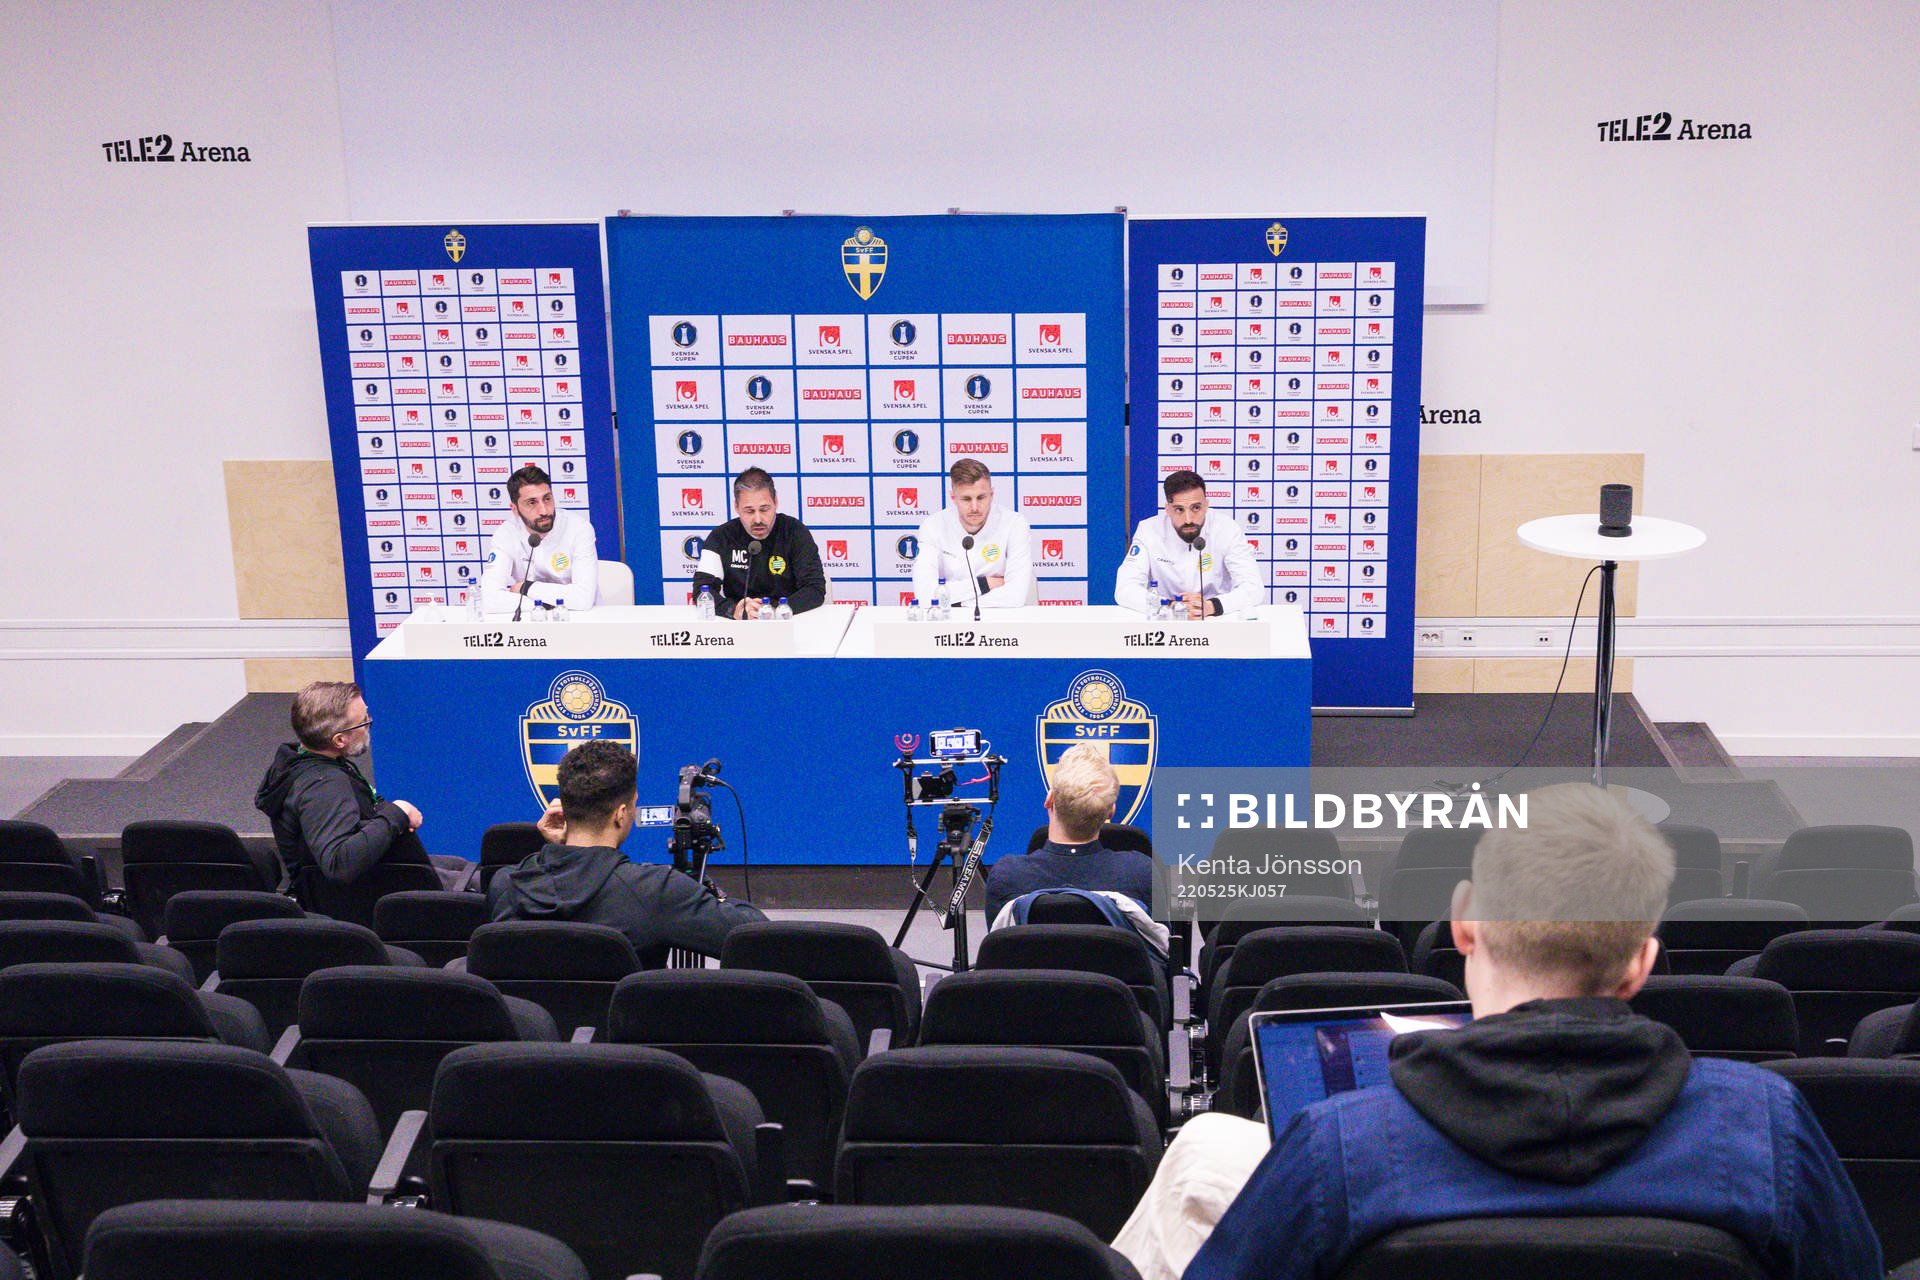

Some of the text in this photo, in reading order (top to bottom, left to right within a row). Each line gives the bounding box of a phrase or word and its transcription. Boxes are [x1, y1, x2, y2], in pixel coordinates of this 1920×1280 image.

[1598, 112, 1752, 142] TELE2 Arena
[102, 134, 251, 162] TELE2 Arena
[728, 335, 787, 345] BAUHAUS
[946, 334, 1006, 344] BAUHAUS
[802, 389, 862, 399] BAUHAUS
[1022, 388, 1081, 398] BAUHAUS
[1420, 405, 1482, 424] Arena
[732, 444, 791, 454] BAUHAUS
[949, 443, 1008, 453] BAUHAUS
[806, 496, 864, 507] BAUHAUS
[1023, 496, 1082, 506] BAUHAUS
[732, 549, 748, 563] MC
[464, 632, 547, 647] TELE2 Arena
[651, 631, 734, 646] TELE2 Arena
[934, 632, 1018, 646] TELE2 Arena
[1124, 631, 1209, 646] TELE2 Arena
[557, 725, 602, 737] SvFF
[1075, 725, 1120, 737] SvFF
